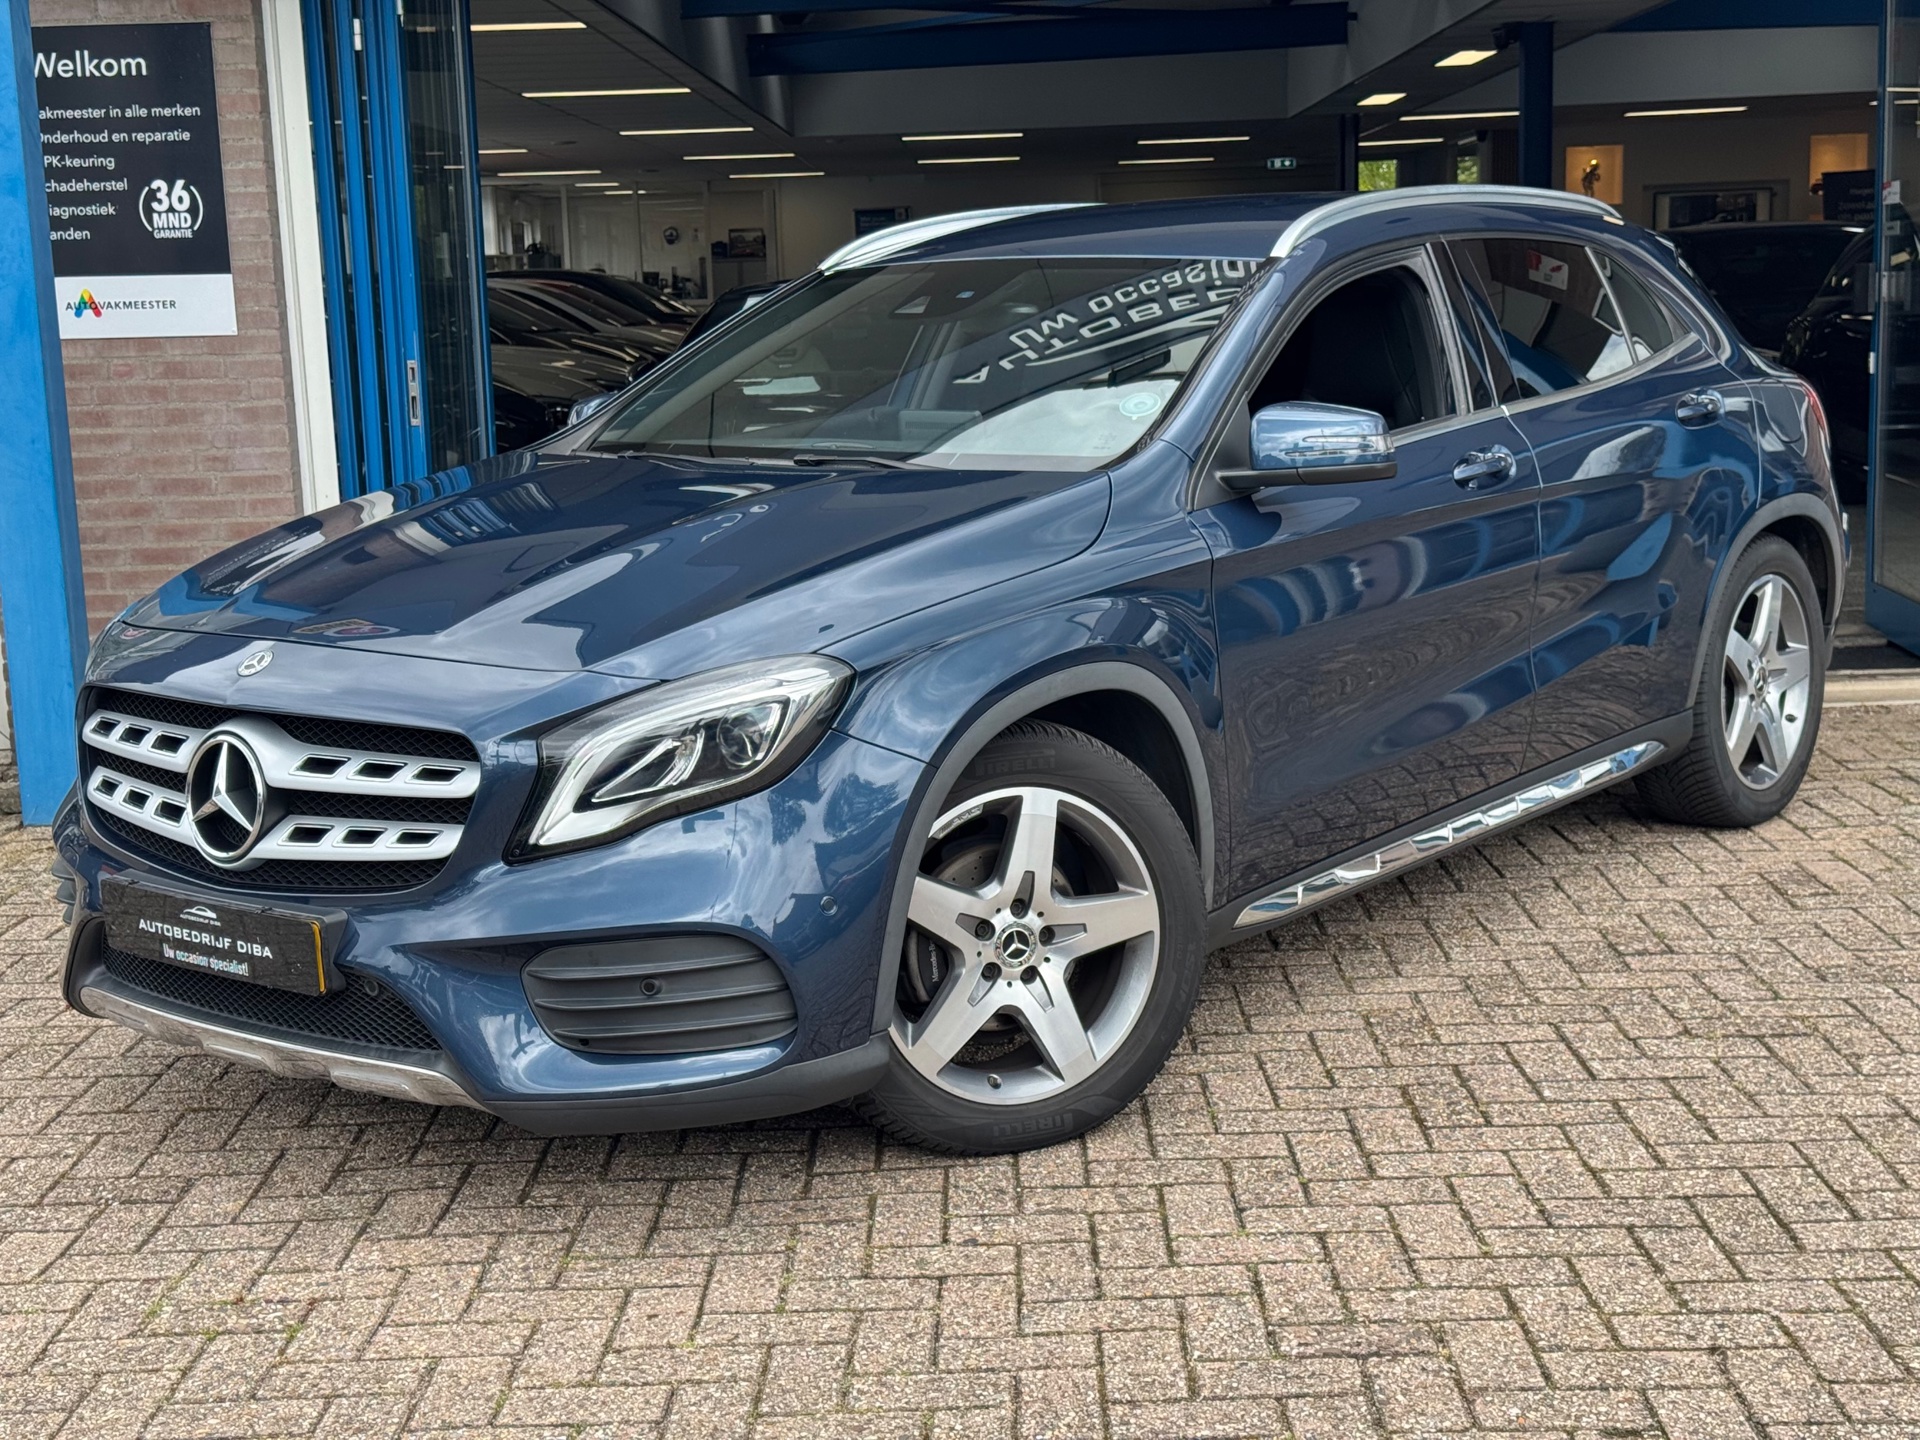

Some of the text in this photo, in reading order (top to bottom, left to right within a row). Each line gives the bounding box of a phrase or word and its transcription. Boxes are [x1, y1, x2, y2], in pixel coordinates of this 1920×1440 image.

[34, 50, 147, 78] Welkom
[39, 103, 201, 119] akmeester in alle merken
[40, 129, 190, 145] nderhoud en reparatie
[43, 155, 115, 170] PK-keuring
[45, 178, 128, 192] chadeherstel
[151, 179, 191, 212] 36
[49, 203, 116, 219] iagnostiek
[152, 212, 192, 229] MND
[50, 228, 91, 240] anden
[153, 229, 193, 239] GARANTIE
[65, 299, 177, 311] AUTOVAKMEESTER
[139, 918, 273, 959] AUTOBEDRIJF DIBA
[163, 943, 249, 976] Uw occasion specialist!
